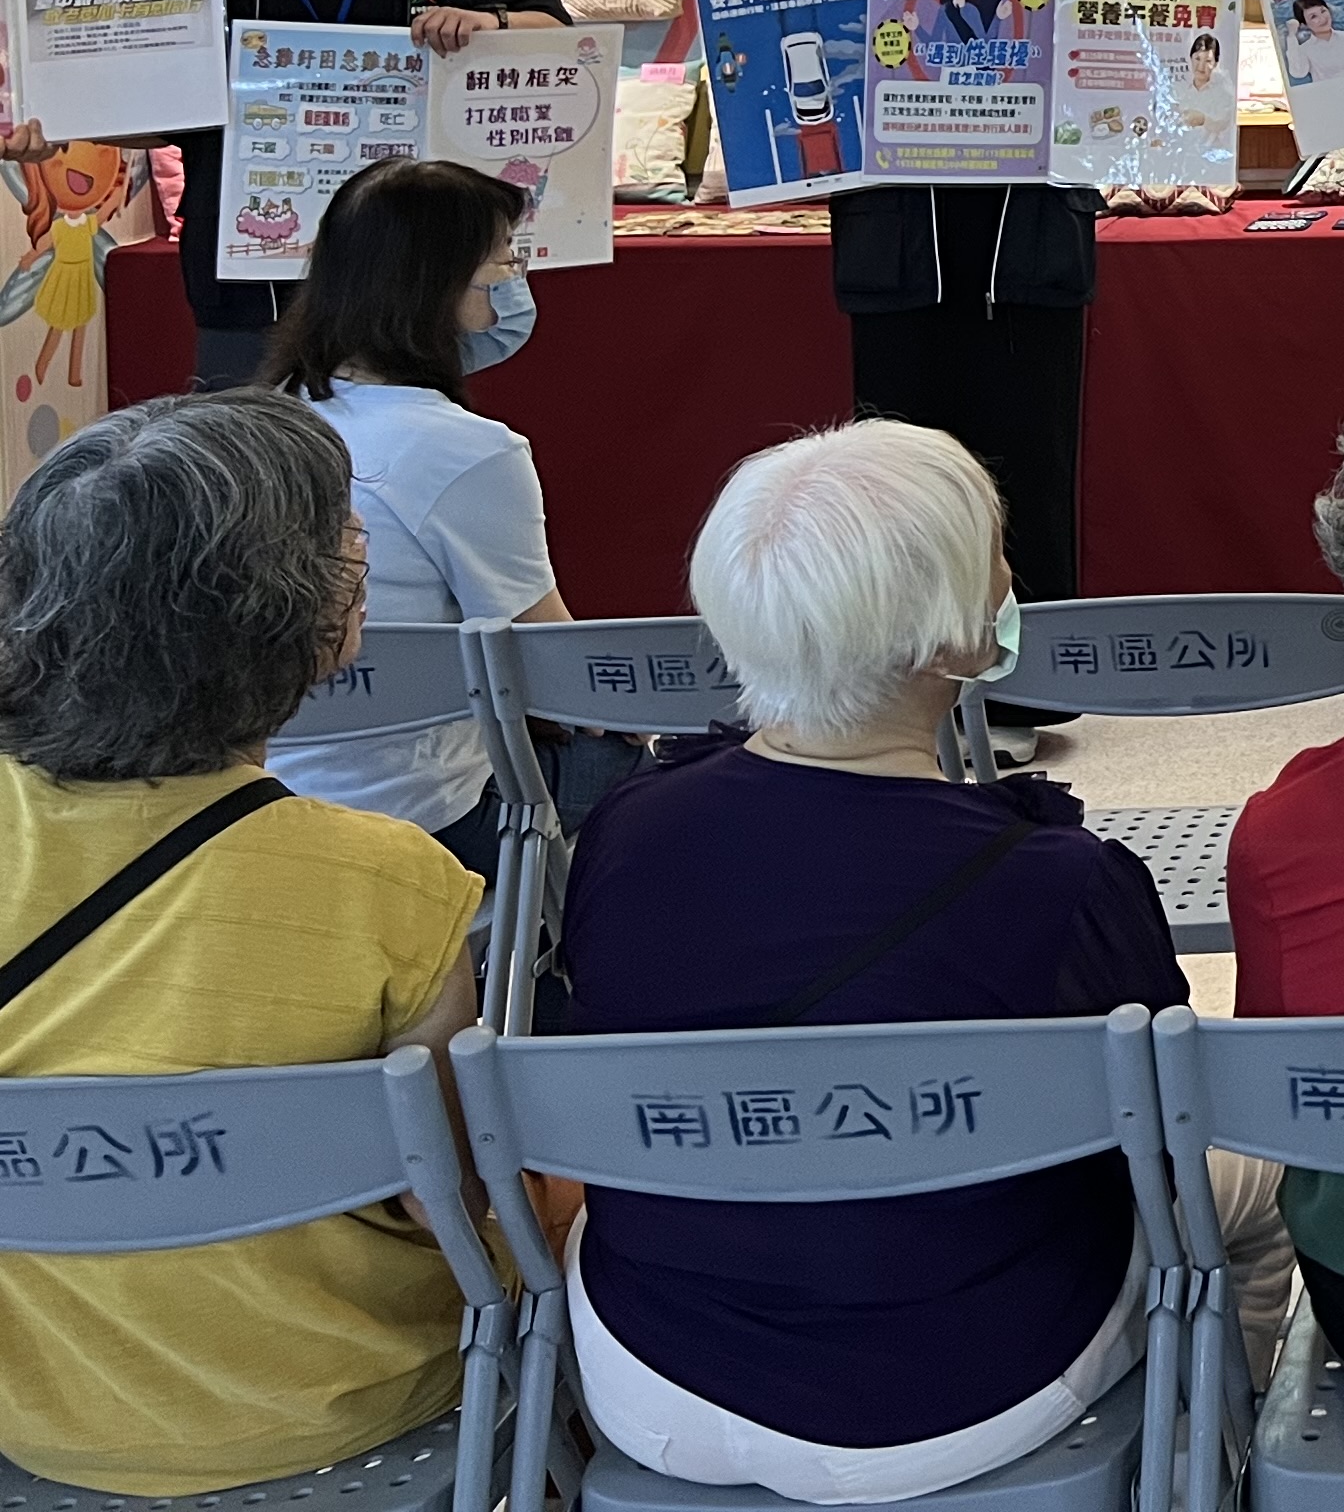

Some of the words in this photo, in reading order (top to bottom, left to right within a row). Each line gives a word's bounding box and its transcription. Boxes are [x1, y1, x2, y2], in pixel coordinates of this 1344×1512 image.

[1078, 1, 1217, 29] 營養午餐免費
[466, 66, 579, 90] 翻轉框架
[465, 104, 552, 126] 打破職業
[487, 126, 575, 147] 性別隔離
[1050, 630, 1270, 674] 南區公所
[631, 1076, 982, 1148] 南區公所
